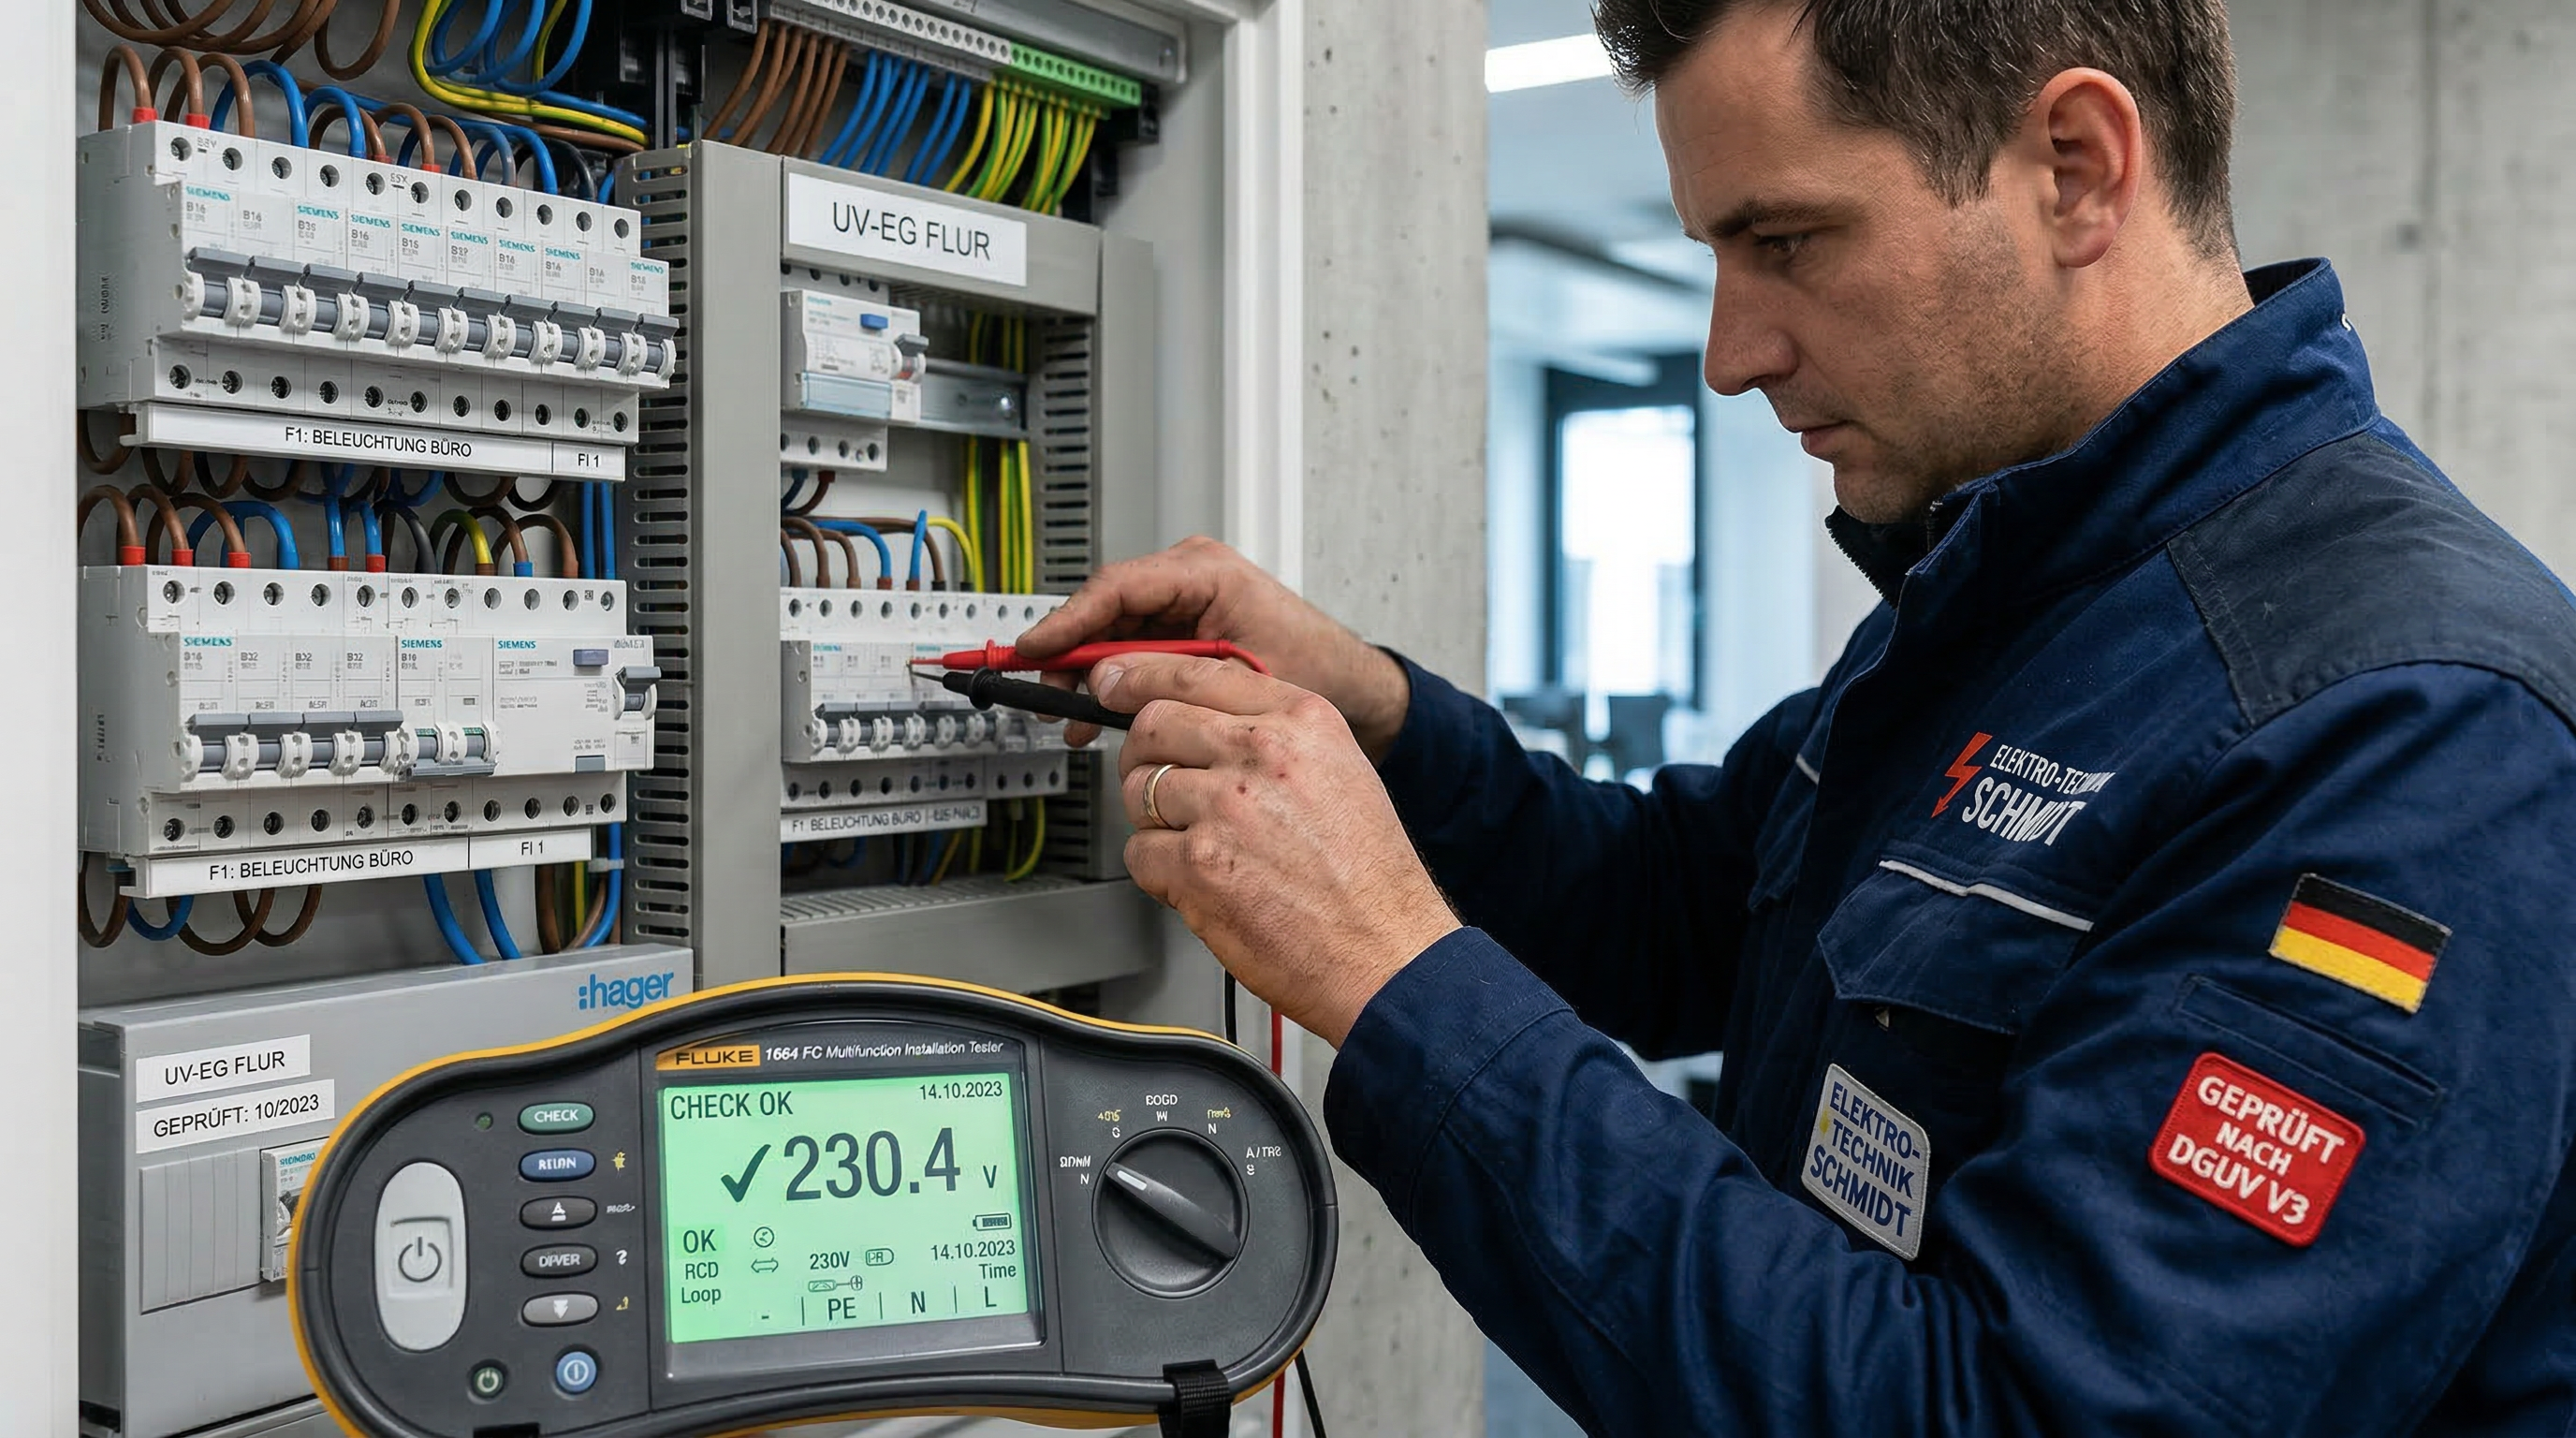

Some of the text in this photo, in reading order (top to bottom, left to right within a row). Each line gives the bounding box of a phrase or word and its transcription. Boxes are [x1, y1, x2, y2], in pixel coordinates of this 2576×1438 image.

[832, 201, 990, 260] UV-EG FLUR
[285, 427, 472, 458] F1: BELEUCHTUNG BÜRO
[593, 455, 600, 468] 1
[402, 639, 443, 649] SIEMENS
[498, 640, 536, 649] SIEMENS
[536, 841, 544, 855] 1
[210, 847, 414, 881] F1: BELEUCHTUNG BÜRO
[165, 1050, 285, 1085] UV-EG FLUR
[676, 1049, 754, 1066] FLUKE
[765, 1047, 798, 1061] 1664
[802, 1045, 823, 1060] FC
[826, 1044, 901, 1060] Multifunction
[919, 1080, 1003, 1100] 14.10.2023
[154, 1093, 319, 1137] GEPRÜFT: 10/2023
[534, 1108, 578, 1123] CHECK
[670, 1091, 793, 1120] CHECK OK
[1830, 1080, 1920, 1160] ELEKTRO-
[2198, 1076, 2346, 1164] GEPRÜFT
[1832, 1118, 1915, 1199] TECHNIK
[2216, 1121, 2292, 1177] NACH
[783, 1127, 961, 1201] 230.4
[1810, 1144, 1911, 1238] SCHMIDT
[2167, 1133, 2310, 1225] DGUV V3
[682, 1229, 717, 1254] OK
[930, 1240, 1016, 1261] 14.10.2023
[685, 1261, 719, 1280] RCD
[810, 1251, 850, 1270] 230V
[979, 1263, 1017, 1281] Time
[681, 1286, 722, 1306] Loop
[827, 1286, 997, 1321] PE N L
